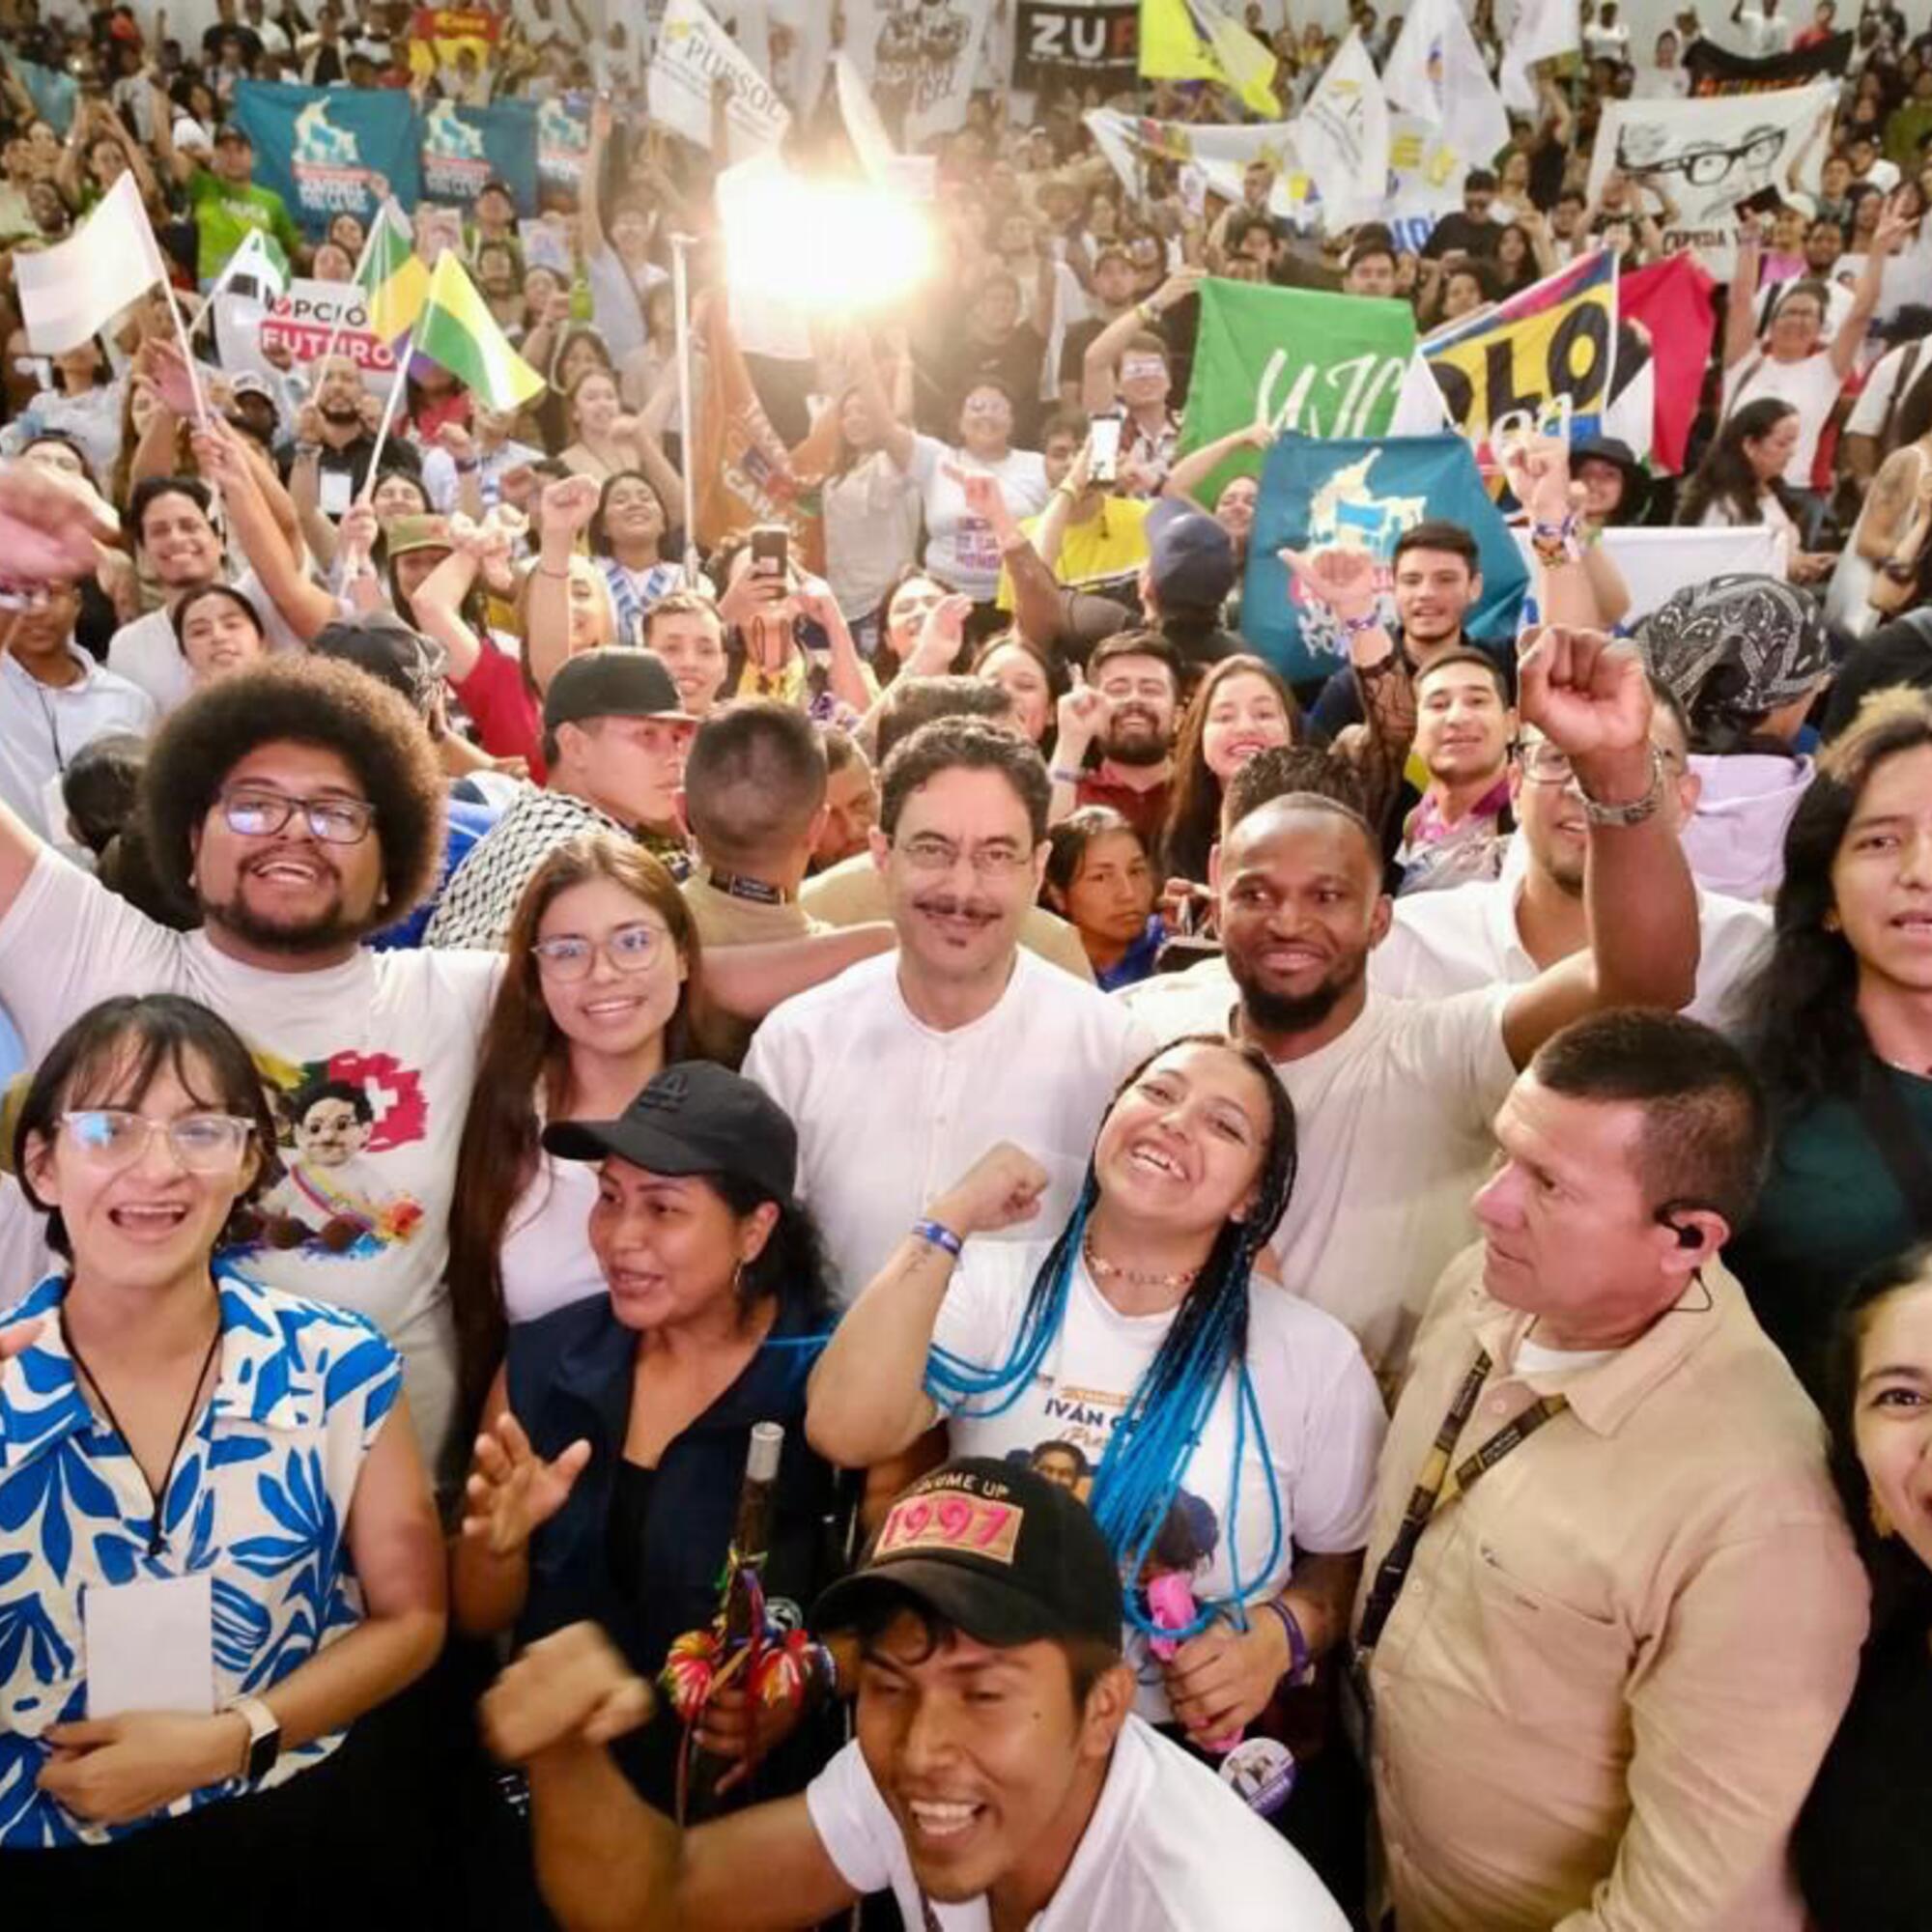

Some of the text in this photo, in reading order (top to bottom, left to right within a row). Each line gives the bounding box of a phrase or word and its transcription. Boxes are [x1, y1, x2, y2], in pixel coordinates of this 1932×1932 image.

[273, 296, 367, 327] OPCIÓ
[1044, 1398, 1104, 1428] IVÁN
[982, 1480, 1009, 1498] UP
[884, 1496, 1010, 1549] 1997
